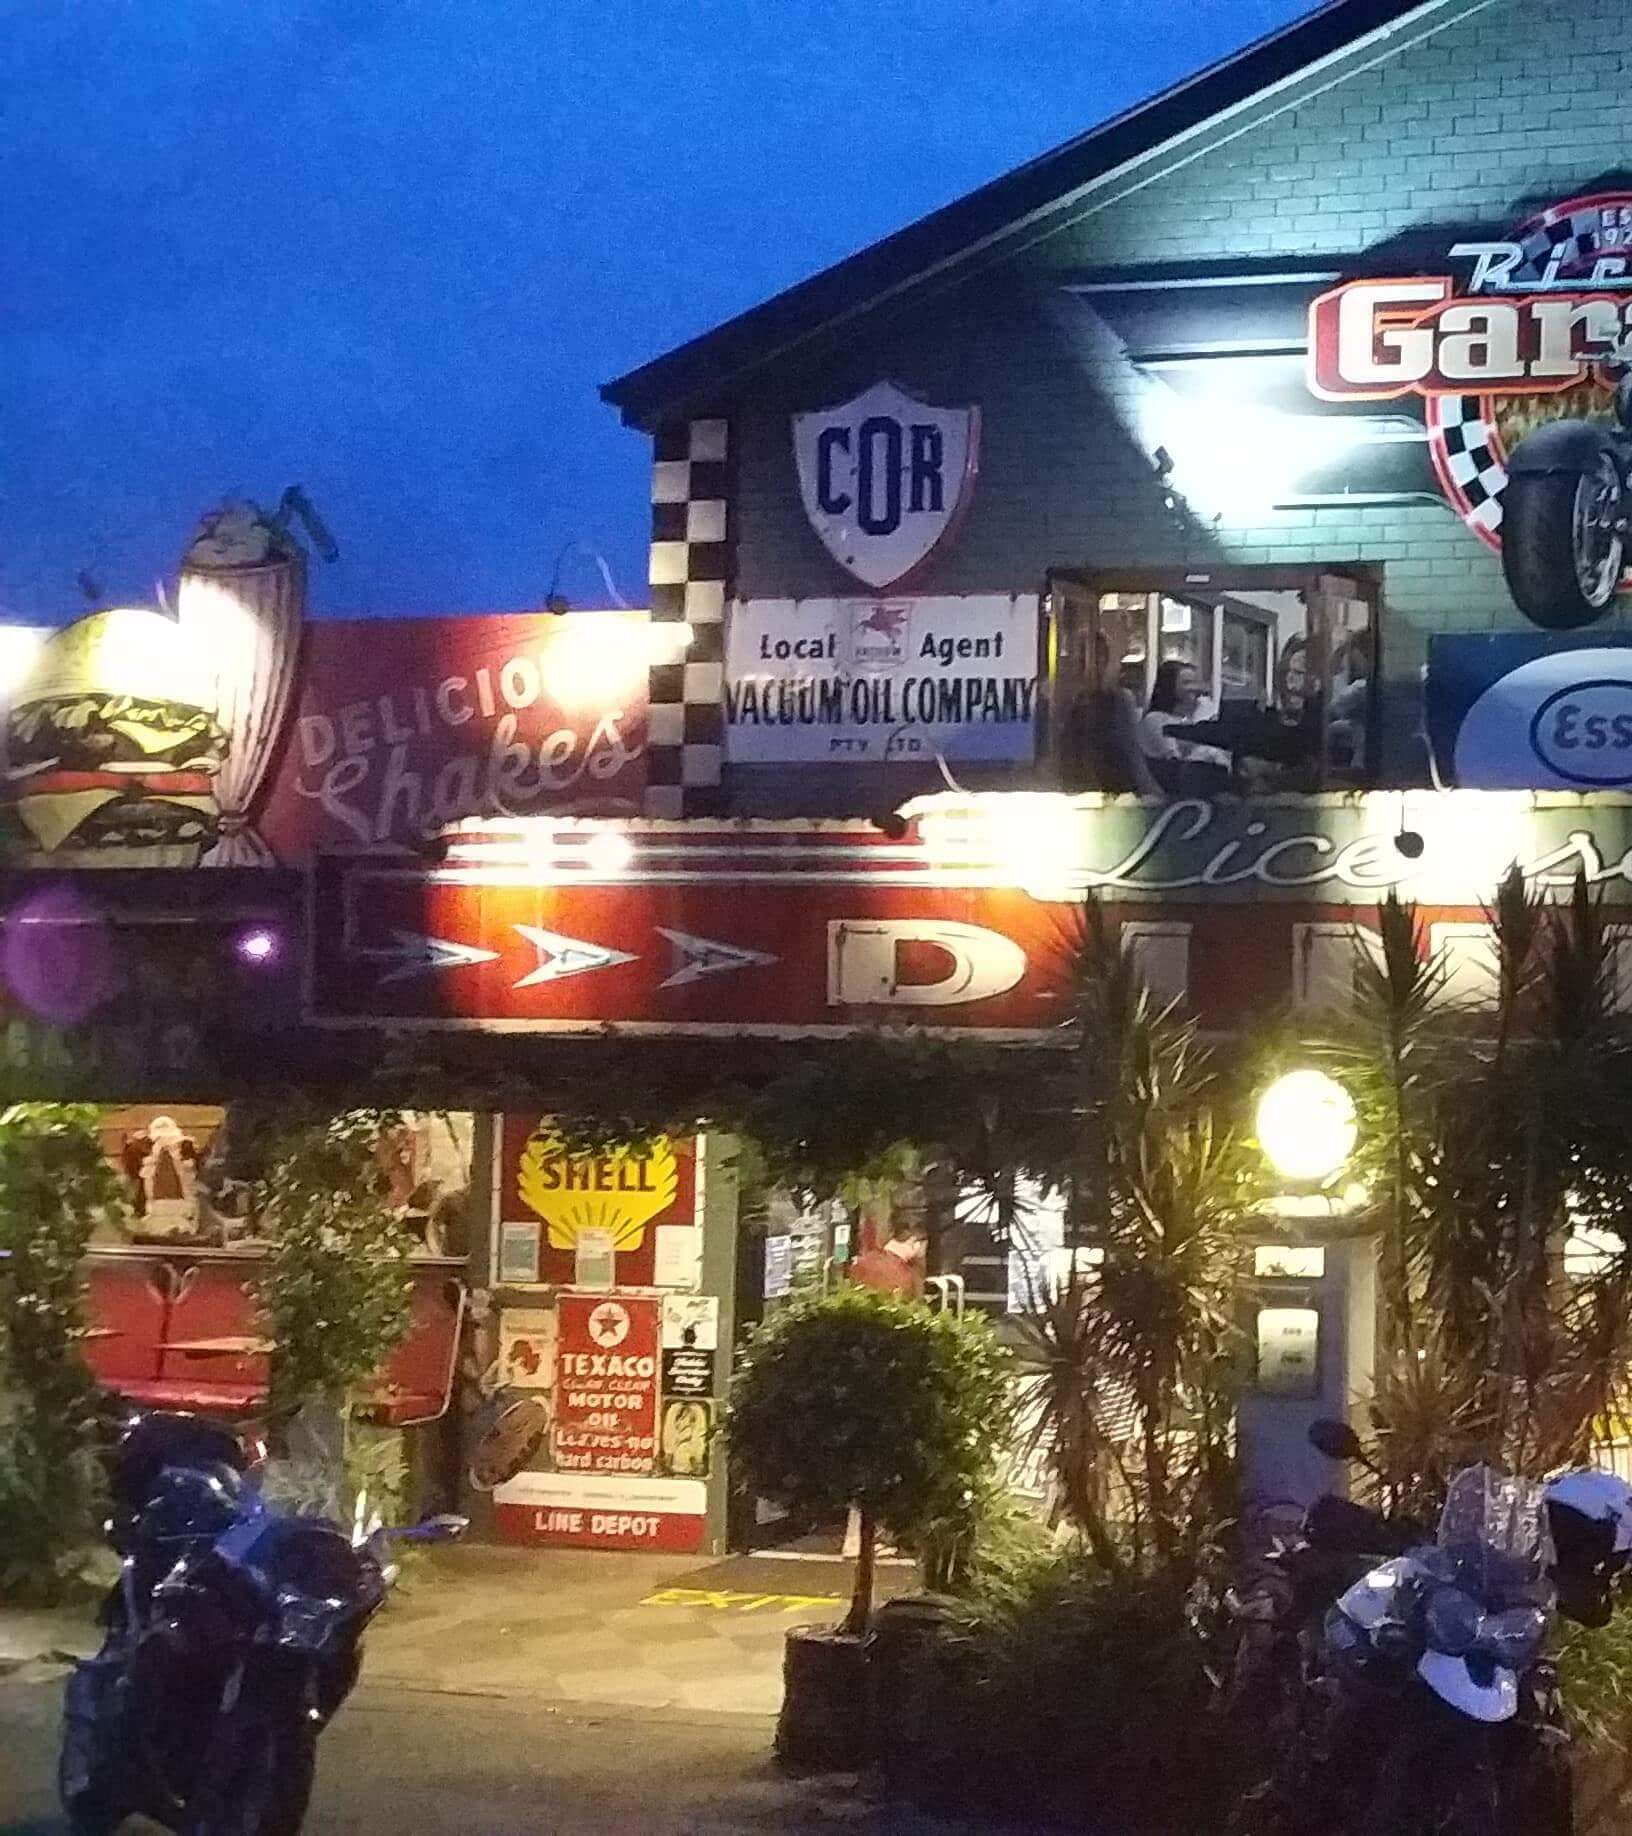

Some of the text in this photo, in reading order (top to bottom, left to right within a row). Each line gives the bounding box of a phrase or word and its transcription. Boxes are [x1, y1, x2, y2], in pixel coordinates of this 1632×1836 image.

[817, 416, 945, 536] COR
[760, 631, 1003, 667] Local Agent
[297, 656, 545, 768] DELICIO
[724, 677, 1037, 726] VACUUM OIL COMPANY
[541, 1155, 656, 1191] SHELL
[560, 1353, 655, 1378] TEXACO
[567, 1392, 643, 1410] MOTOR
[588, 1412, 618, 1428] OIL
[591, 1514, 660, 1537] DEPOT
